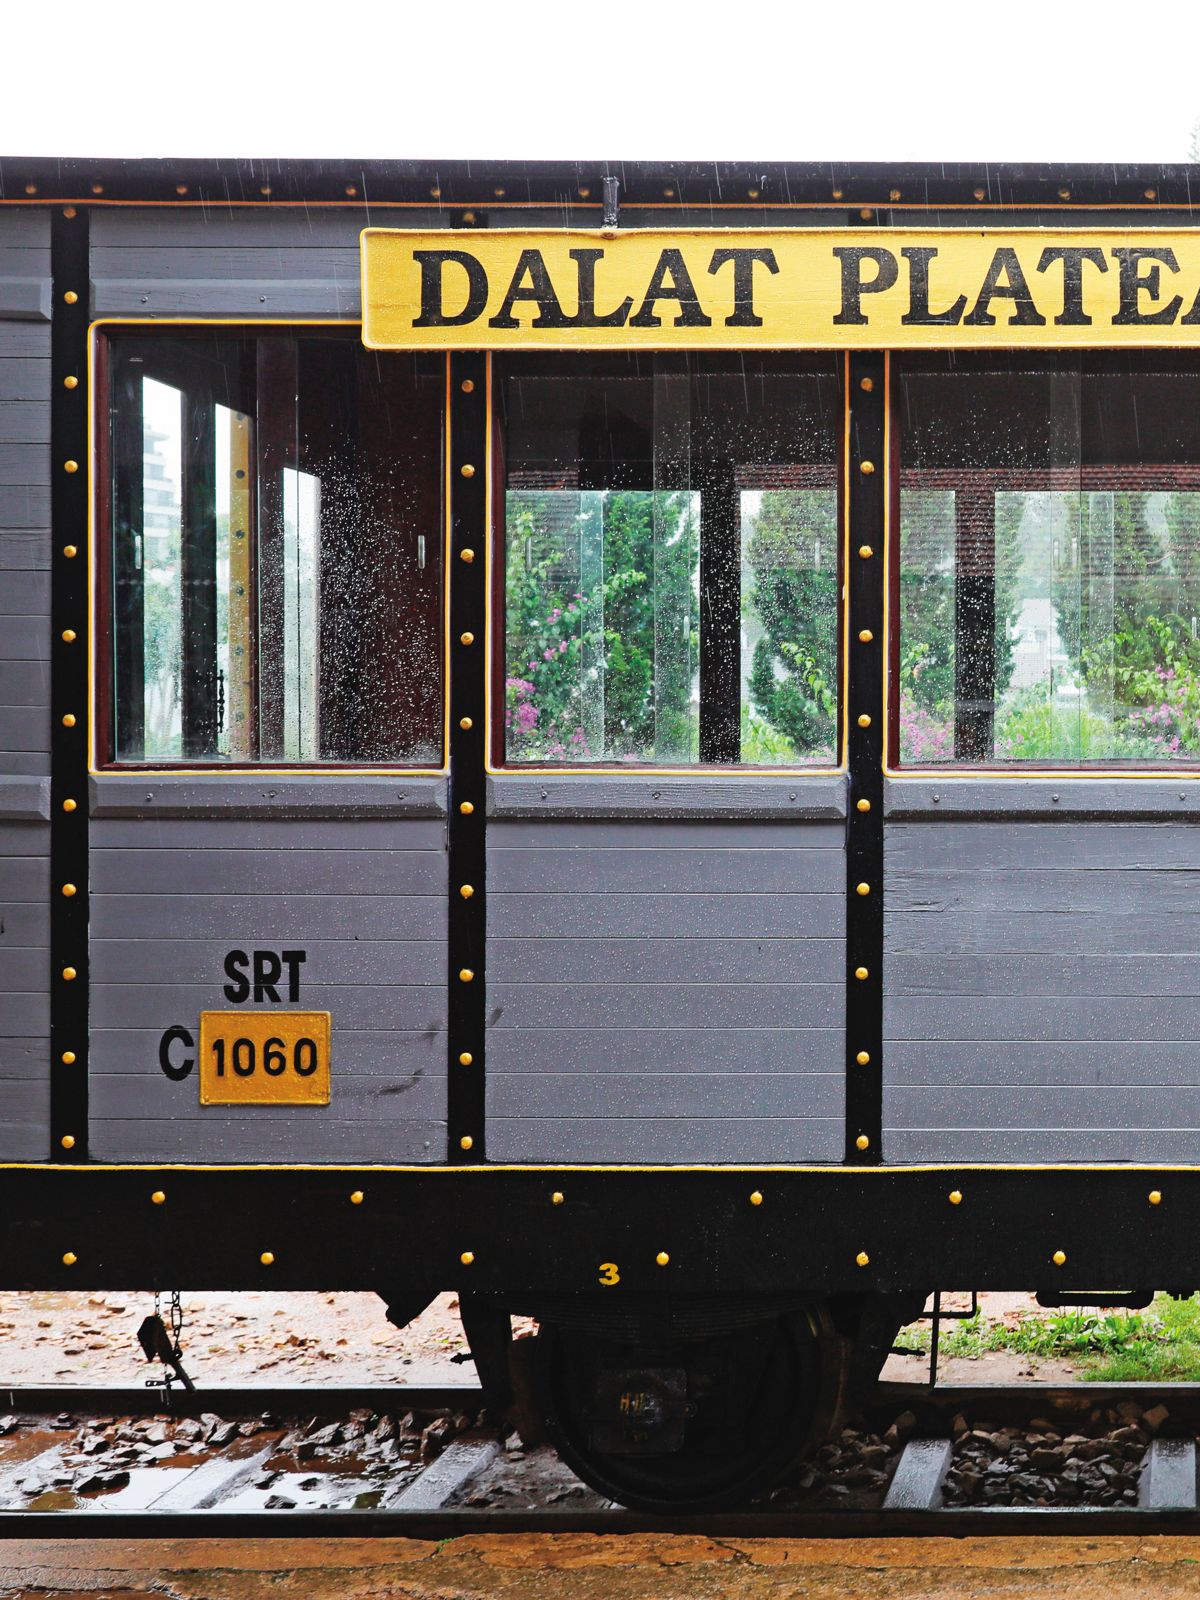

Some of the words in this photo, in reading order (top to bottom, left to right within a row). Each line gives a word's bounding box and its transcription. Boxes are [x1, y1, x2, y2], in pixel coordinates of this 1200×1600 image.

[412, 248, 780, 329] DALAT
[223, 949, 306, 1004] SRT
[159, 1025, 195, 1082] C
[212, 1037, 318, 1077] 1060
[598, 1262, 621, 1286] 3
